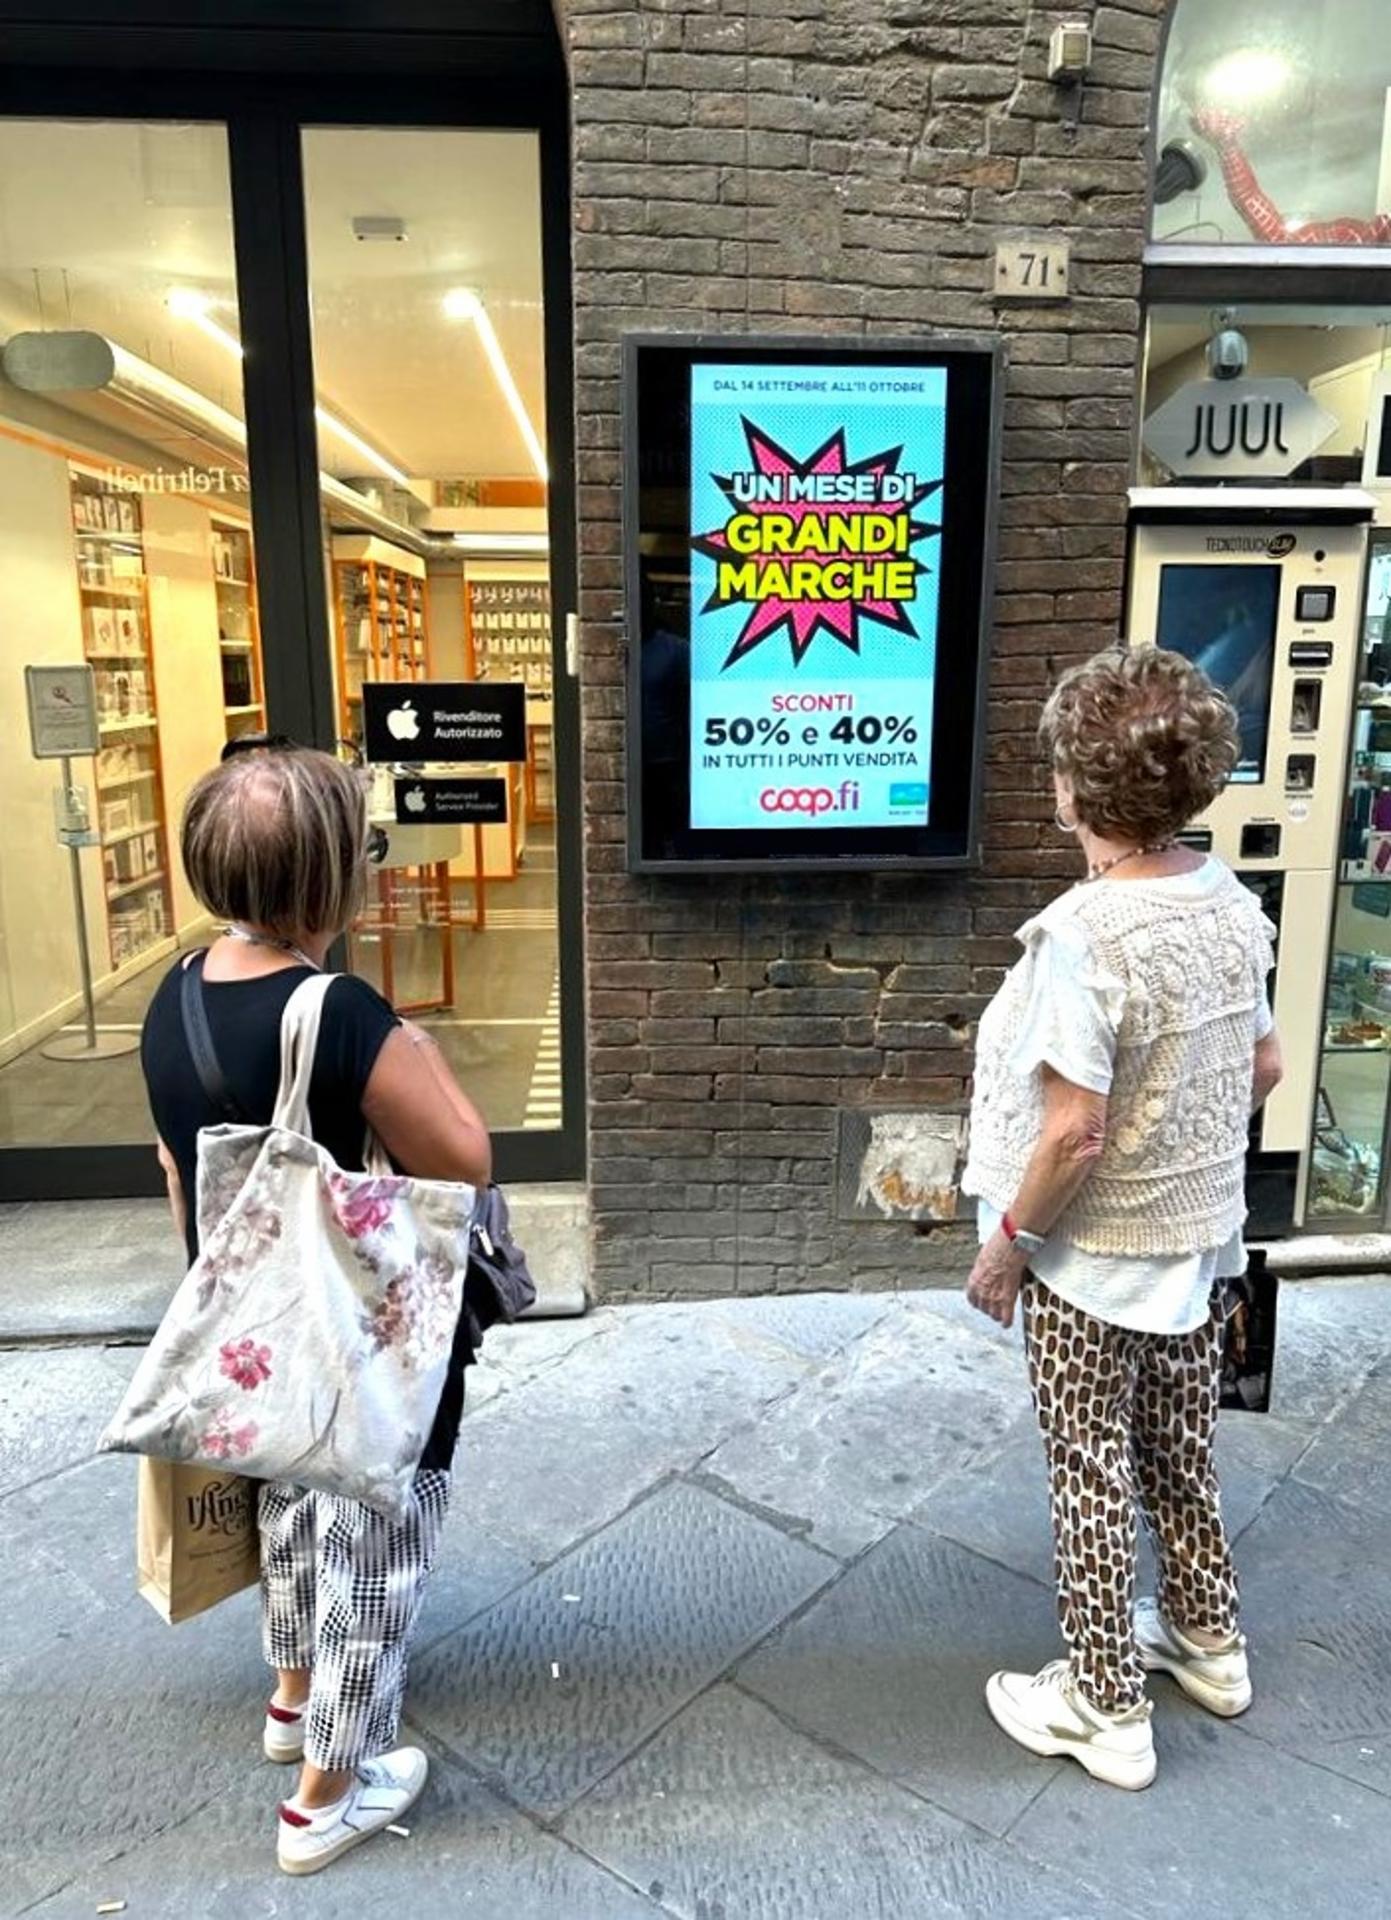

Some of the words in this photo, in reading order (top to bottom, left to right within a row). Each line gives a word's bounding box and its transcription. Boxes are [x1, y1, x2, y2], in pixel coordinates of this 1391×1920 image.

[1018, 253, 1049, 287] 71
[713, 380, 738, 391] DAL
[741, 380, 754, 391] 14
[757, 380, 827, 392] SETTEMBRE
[869, 381, 925, 393] OTTOBRE
[1185, 402, 1289, 457] JUUL
[732, 473, 783, 503] UN
[789, 473, 876, 503] MESE
[881, 473, 916, 503] DI
[725, 512, 910, 555] GRANDI
[718, 560, 916, 601] MARCHE
[433, 710, 502, 723] Rivenditore
[771, 694, 853, 712] SCONTI
[433, 727, 503, 739] Autorizzato
[704, 717, 791, 746] 50%
[801, 727, 819, 745] e
[829, 715, 918, 745] 40%
[703, 754, 721, 768] IN
[726, 754, 774, 768] TUTTI
[787, 752, 839, 767] PUNTI
[843, 752, 918, 767] VENDITA
[759, 780, 860, 817] coop.fi
